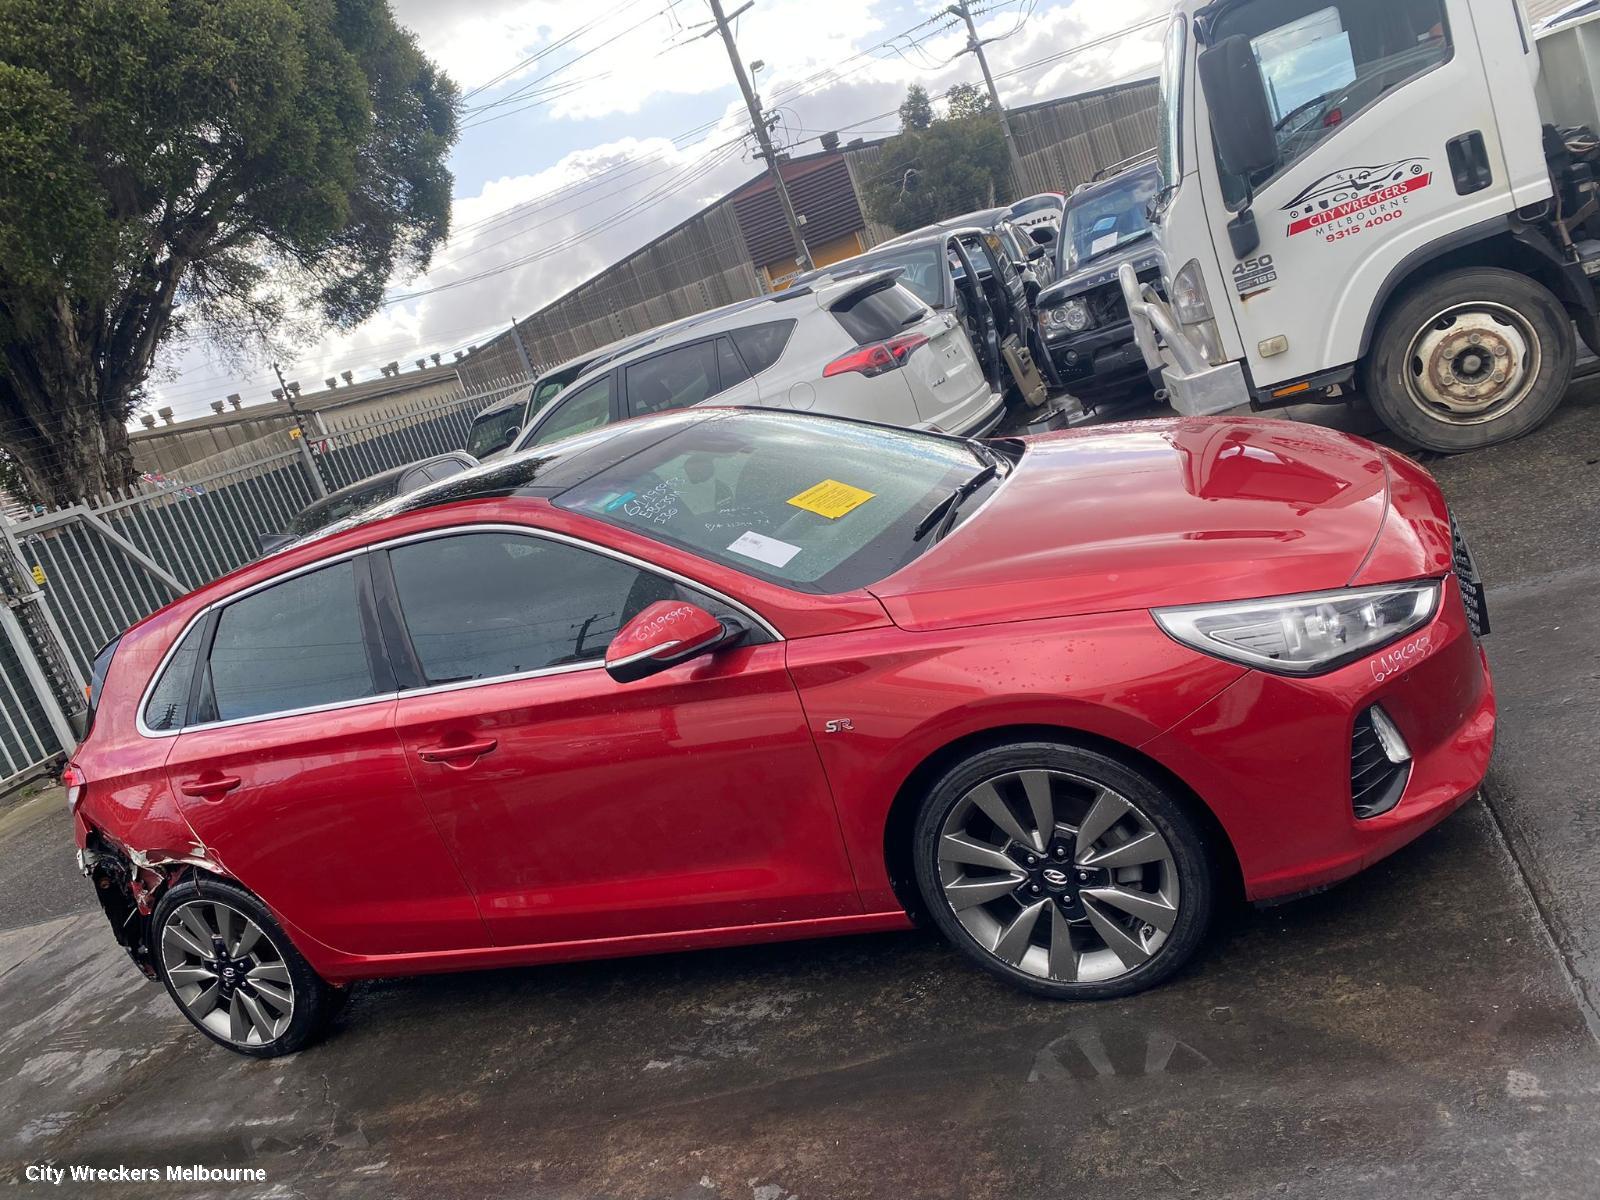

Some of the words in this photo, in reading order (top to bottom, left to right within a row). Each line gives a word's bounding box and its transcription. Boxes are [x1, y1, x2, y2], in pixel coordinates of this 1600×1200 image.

[1309, 208, 1336, 227] CITY
[1338, 183, 1408, 214] WRECKERS
[1316, 196, 1409, 237] MELBOURNE
[1326, 225, 1360, 243] 9315
[1364, 209, 1403, 228] 4000
[1232, 254, 1273, 275] 450
[1253, 271, 1276, 285] 185
[635, 606, 694, 641] 61195953
[825, 718, 855, 733] SR
